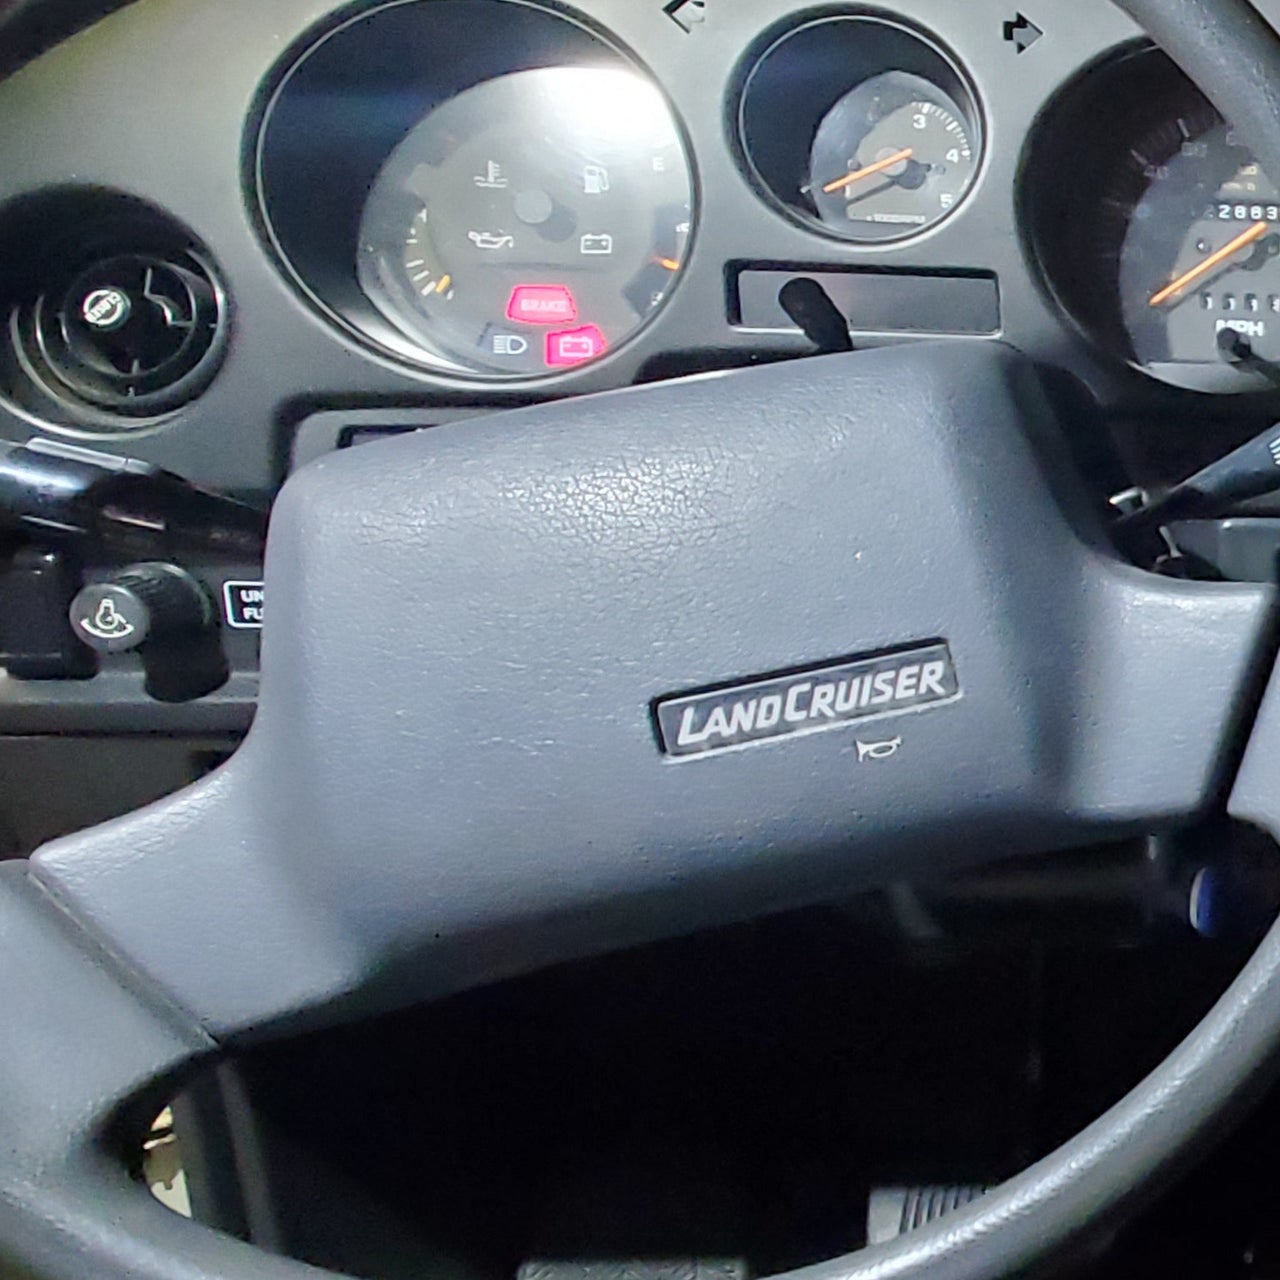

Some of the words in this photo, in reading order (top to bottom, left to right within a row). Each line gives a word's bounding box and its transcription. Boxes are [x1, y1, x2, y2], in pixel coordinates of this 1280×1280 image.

[912, 114, 927, 129] 3
[945, 148, 960, 163] 4
[521, 299, 568, 312] BRAKE
